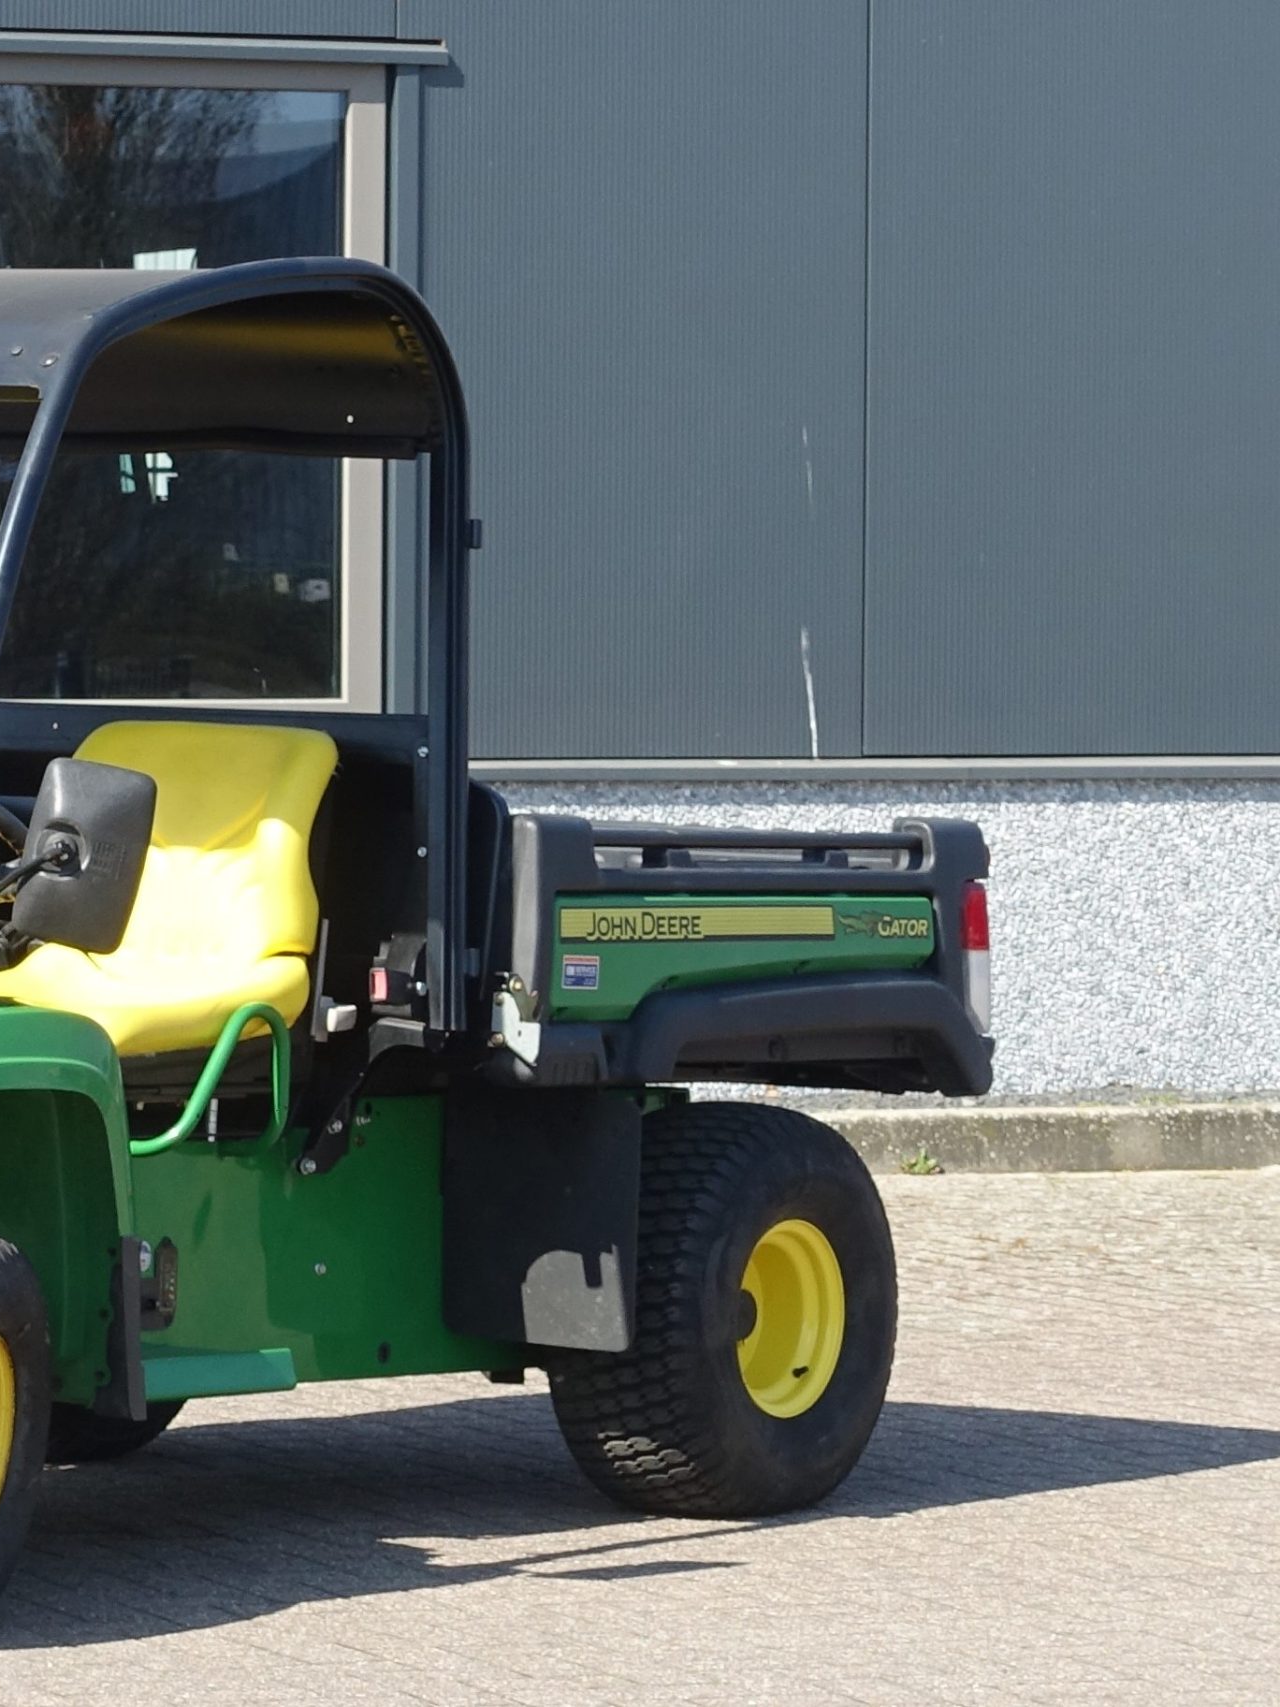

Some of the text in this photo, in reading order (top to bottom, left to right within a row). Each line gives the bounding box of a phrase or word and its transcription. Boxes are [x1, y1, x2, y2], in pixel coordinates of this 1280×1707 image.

[586, 911, 702, 937] JOHN DEERE
[877, 915, 928, 937] GATOR
